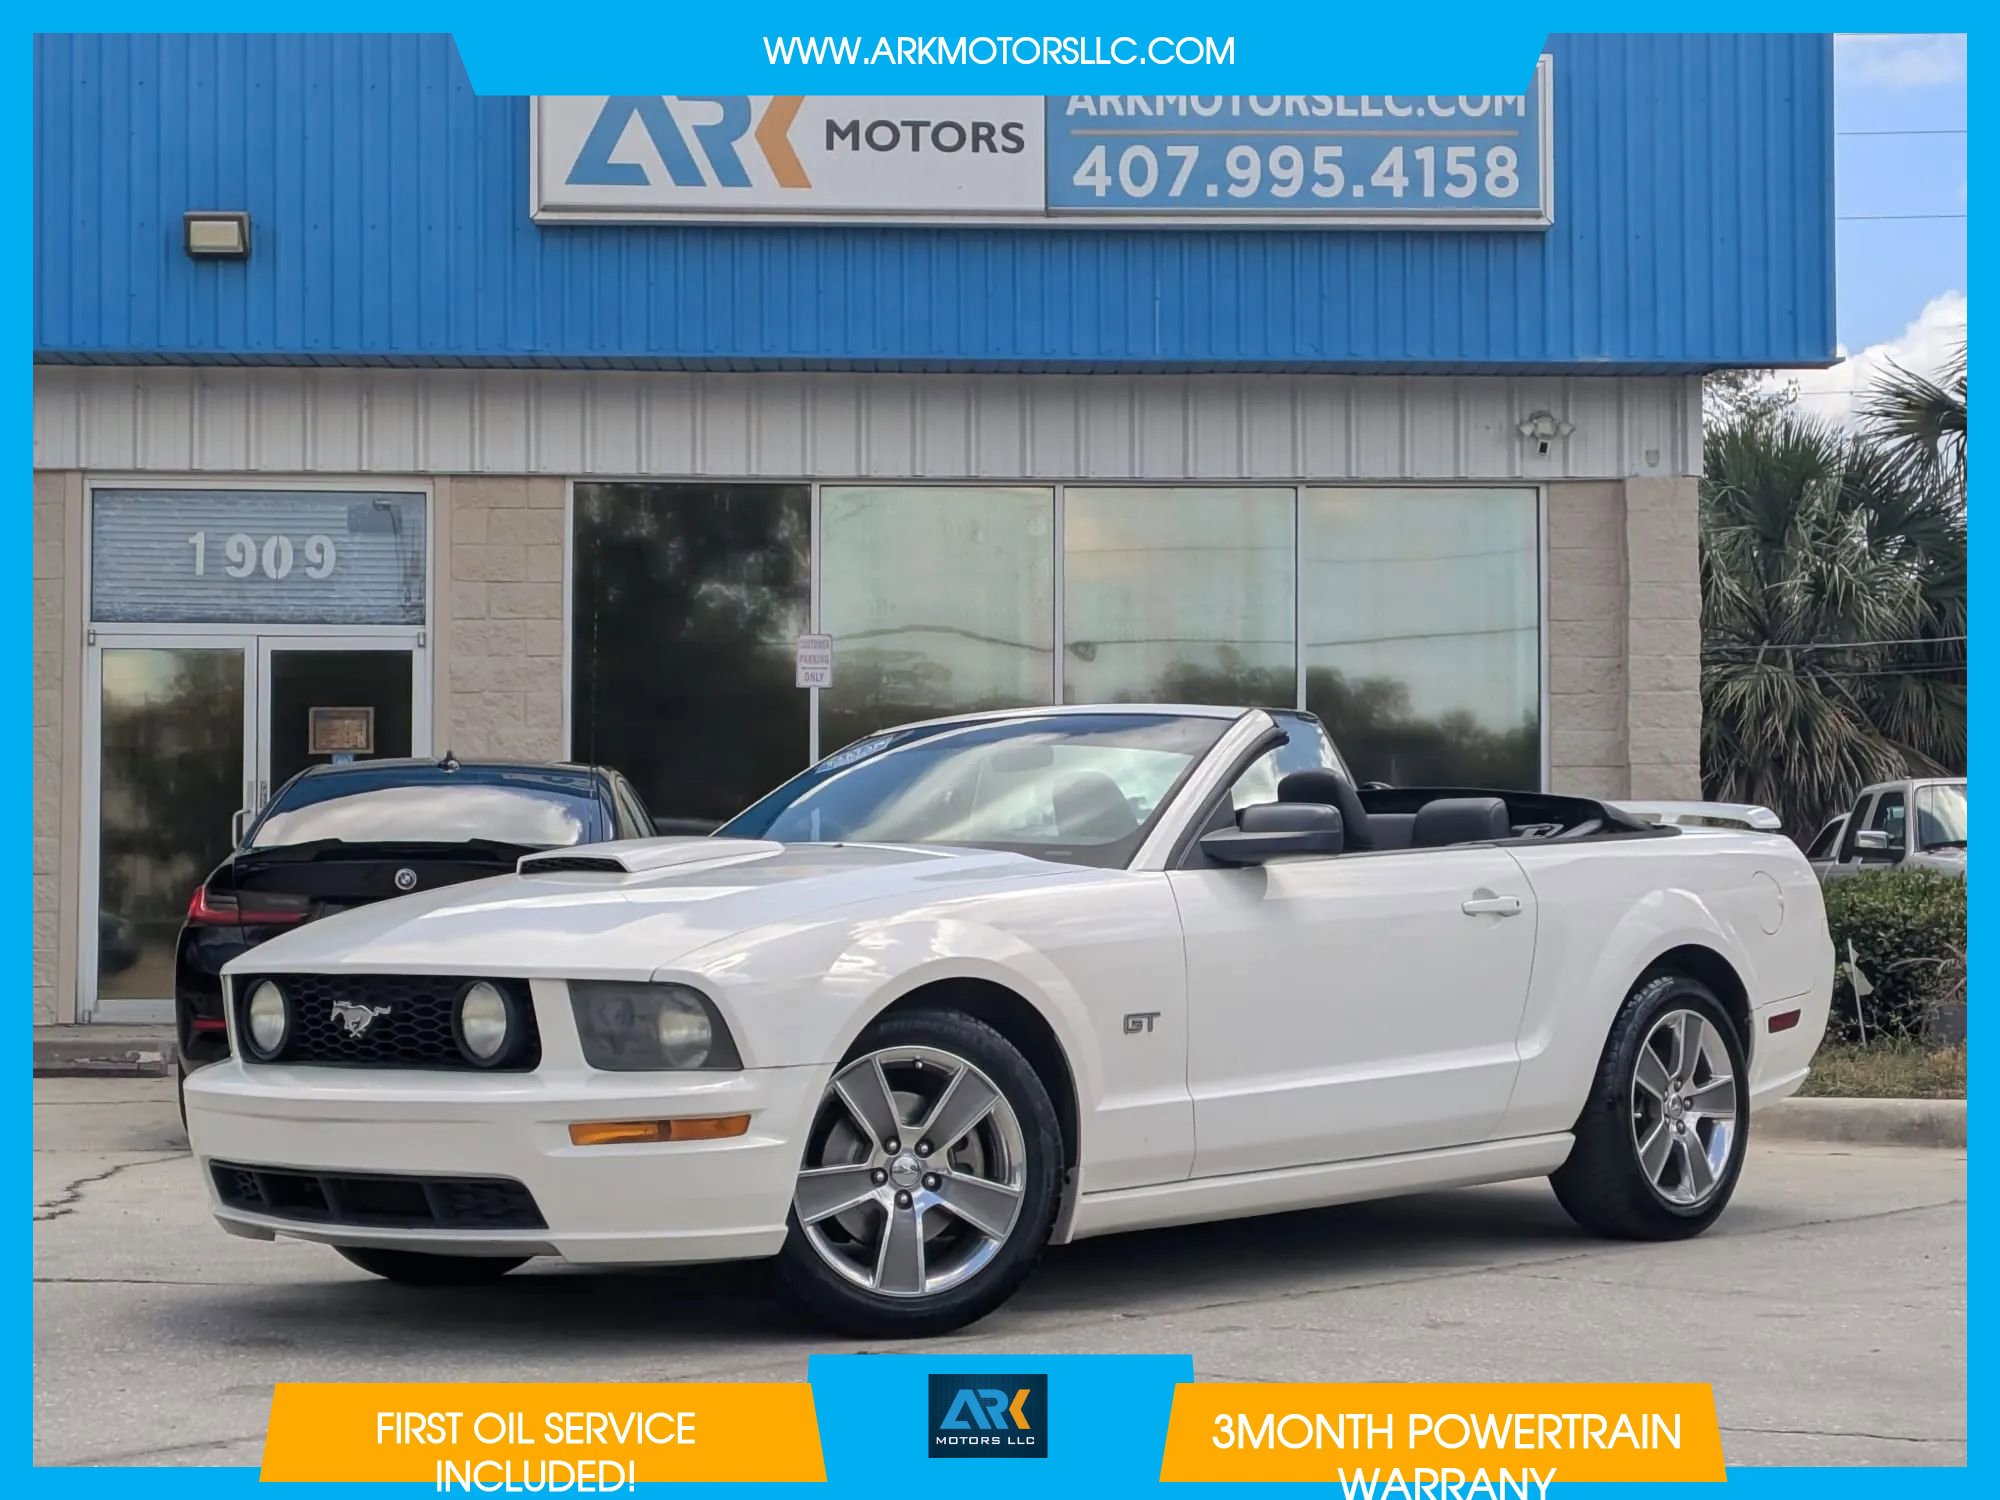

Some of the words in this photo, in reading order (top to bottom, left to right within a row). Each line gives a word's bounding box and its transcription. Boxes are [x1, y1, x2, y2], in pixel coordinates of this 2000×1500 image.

[1066, 95, 1525, 117] ARKMOTORSLLC.COM
[564, 96, 812, 188] ARK
[825, 119, 1025, 153] MOTORS
[1073, 145, 1520, 198] 407.995.4158
[188, 531, 336, 580] 1909
[804, 671, 825, 681] ONLY
[1123, 1011, 1161, 1034] GT
